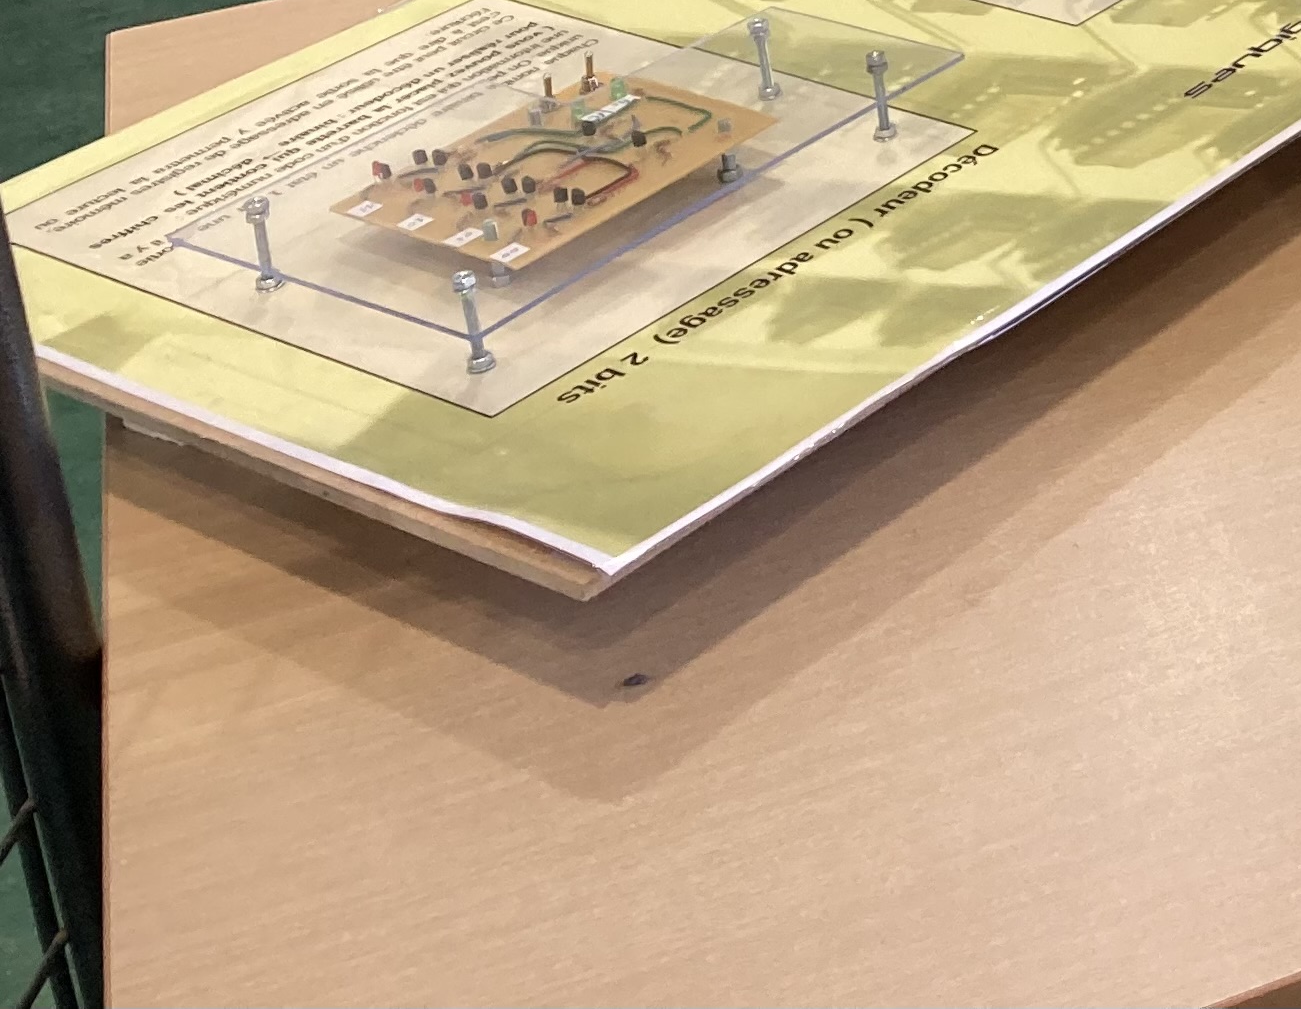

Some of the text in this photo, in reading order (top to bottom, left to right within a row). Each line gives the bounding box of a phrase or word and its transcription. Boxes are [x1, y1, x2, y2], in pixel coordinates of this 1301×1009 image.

[874, 144, 999, 218] Décodeur
[815, 227, 854, 252] ou
[653, 251, 815, 346] adressage)
[621, 351, 649, 367] 2
[557, 367, 626, 405] bits
